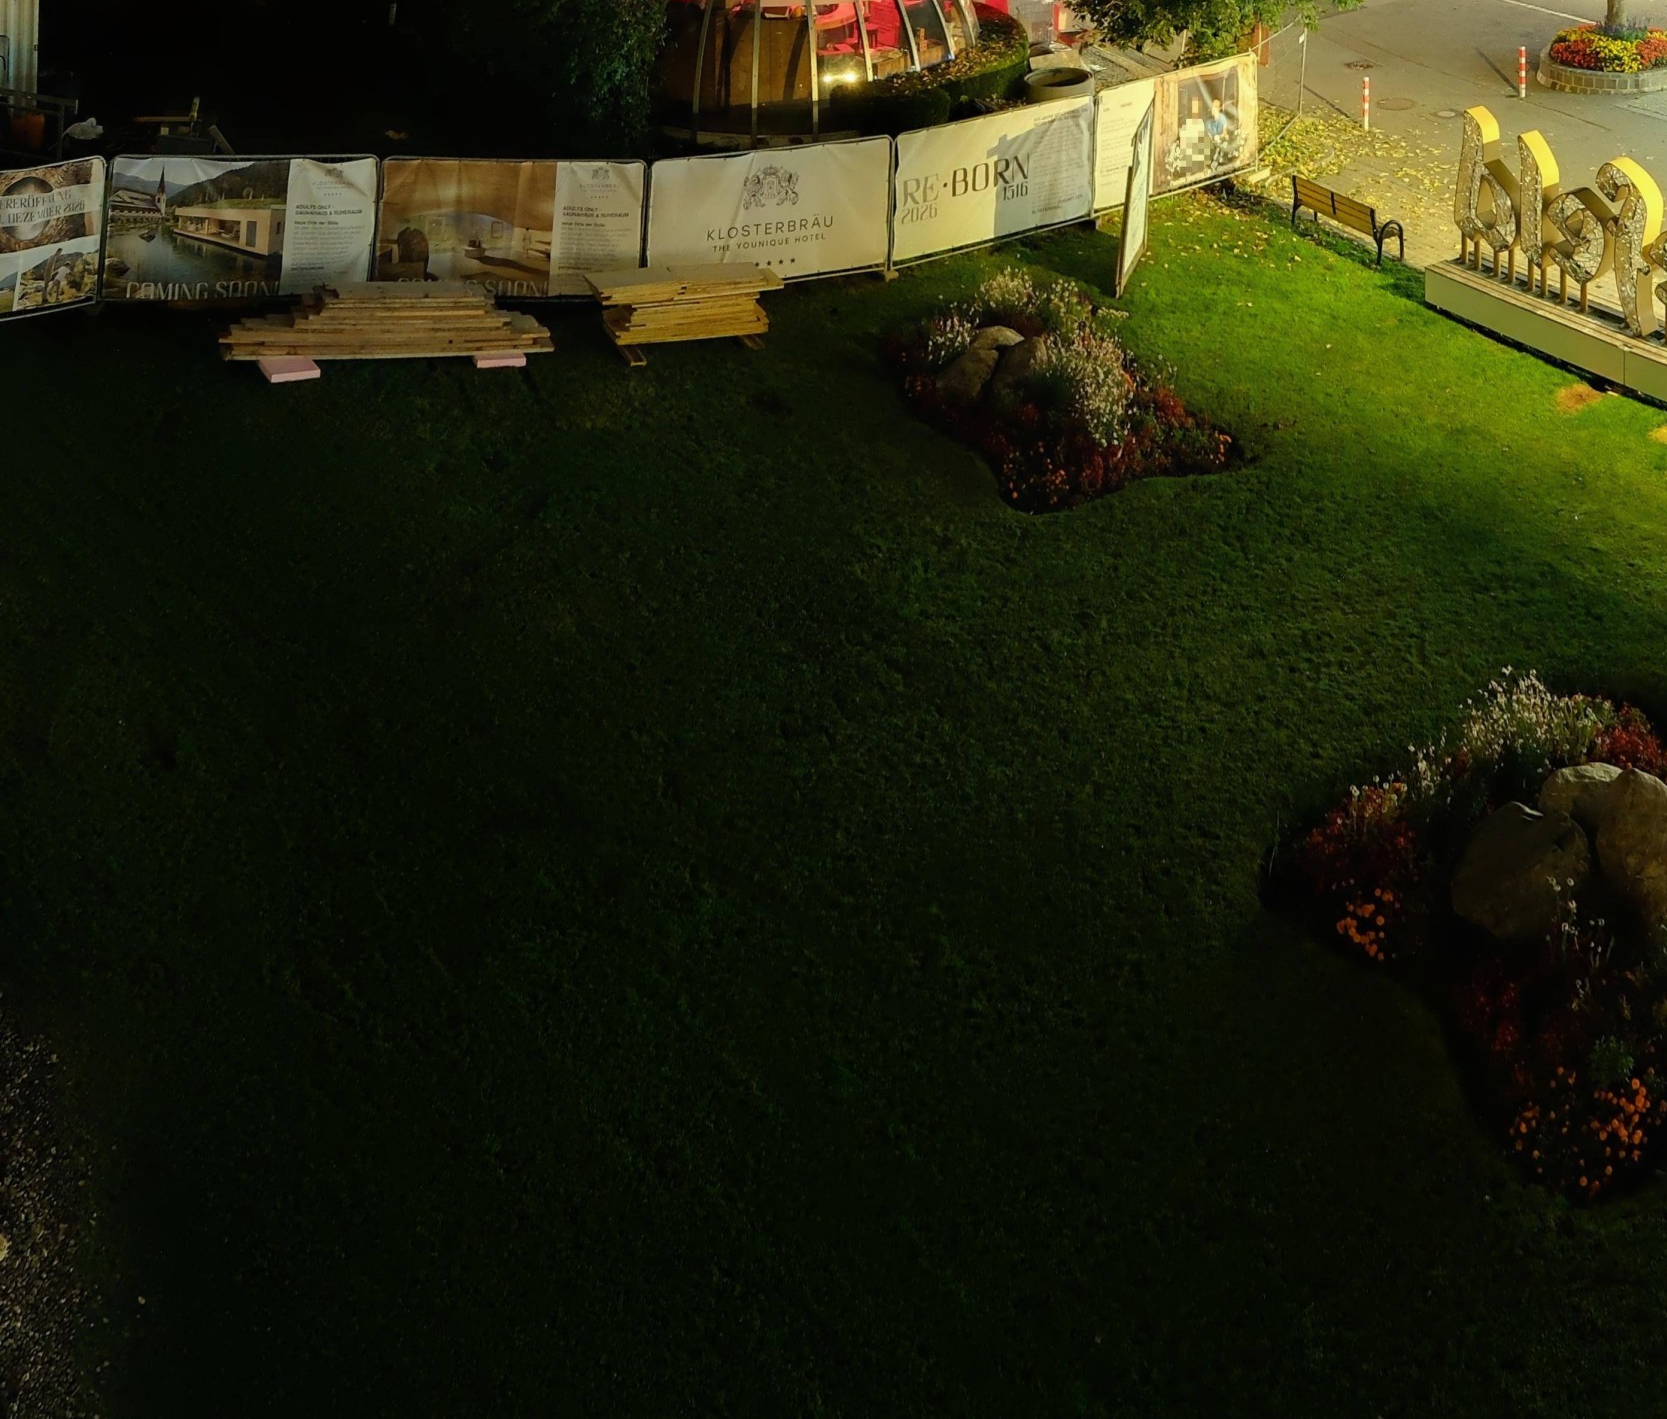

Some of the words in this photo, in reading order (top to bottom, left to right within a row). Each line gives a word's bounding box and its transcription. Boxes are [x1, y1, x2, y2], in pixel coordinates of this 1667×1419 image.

[1002, 181, 1029, 201] 1516
[901, 203, 938, 225] 2026
[706, 214, 835, 241] KLOSTERBRÄU
[712, 244, 731, 253] THE
[736, 237, 790, 250] YOUNIQUE
[794, 233, 826, 244] HOTEL
